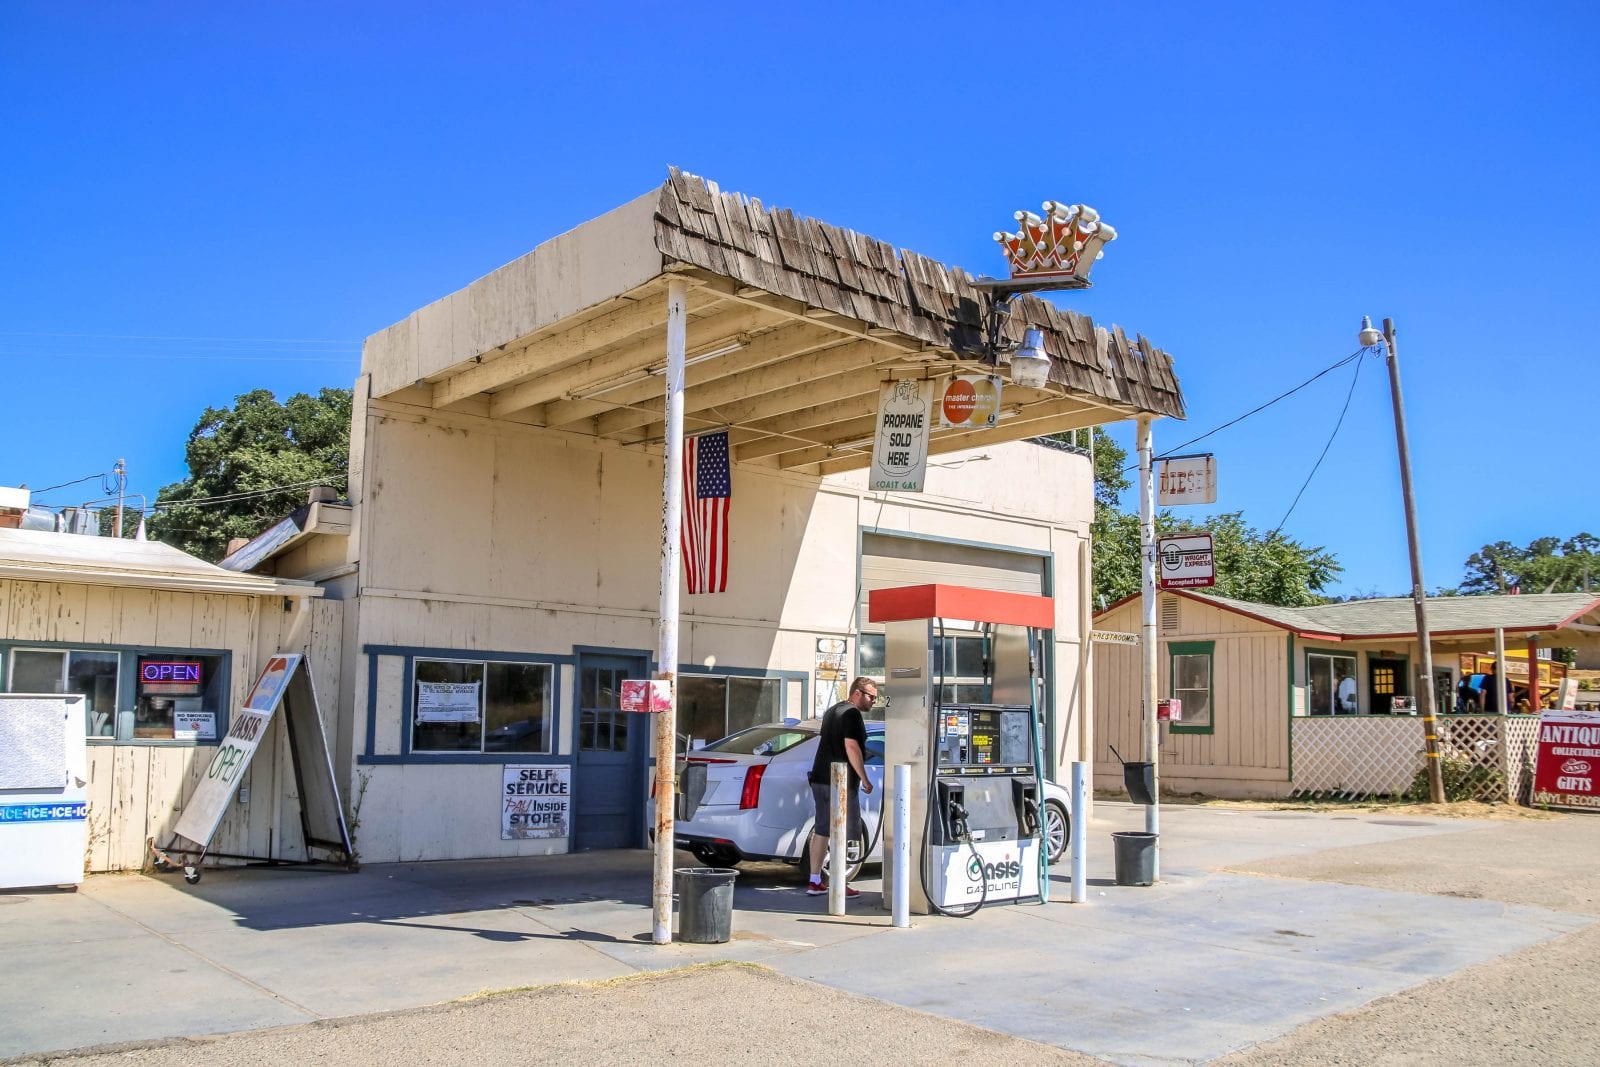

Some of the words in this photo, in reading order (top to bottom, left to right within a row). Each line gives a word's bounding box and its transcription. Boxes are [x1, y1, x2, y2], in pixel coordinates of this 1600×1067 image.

[945, 393, 969, 402] master
[971, 393, 996, 403] char
[883, 413, 923, 429] PROPANE
[889, 433, 912, 448] SOLD
[887, 451, 910, 466] HERE
[876, 480, 899, 490] COAST
[902, 480, 917, 490] GAS
[1184, 554, 1208, 562] WRIGHT
[1184, 560, 1212, 568] EXPRESS
[1097, 633, 1135, 642] RESTROOMS
[144, 664, 199, 681] OPEN
[885, 696, 891, 707] 2
[230, 714, 262, 742] OASIS
[1540, 725, 1600, 746] ANTIQU
[209, 744, 250, 787] OPEN
[520, 769, 553, 781] SELF
[506, 783, 567, 795] SERVICE
[1556, 776, 1592, 791] GIFTS
[505, 797, 532, 813] PAY
[533, 800, 567, 812] INSIDE
[1534, 791, 1564, 805] VINYL
[510, 813, 561, 825] STORE
